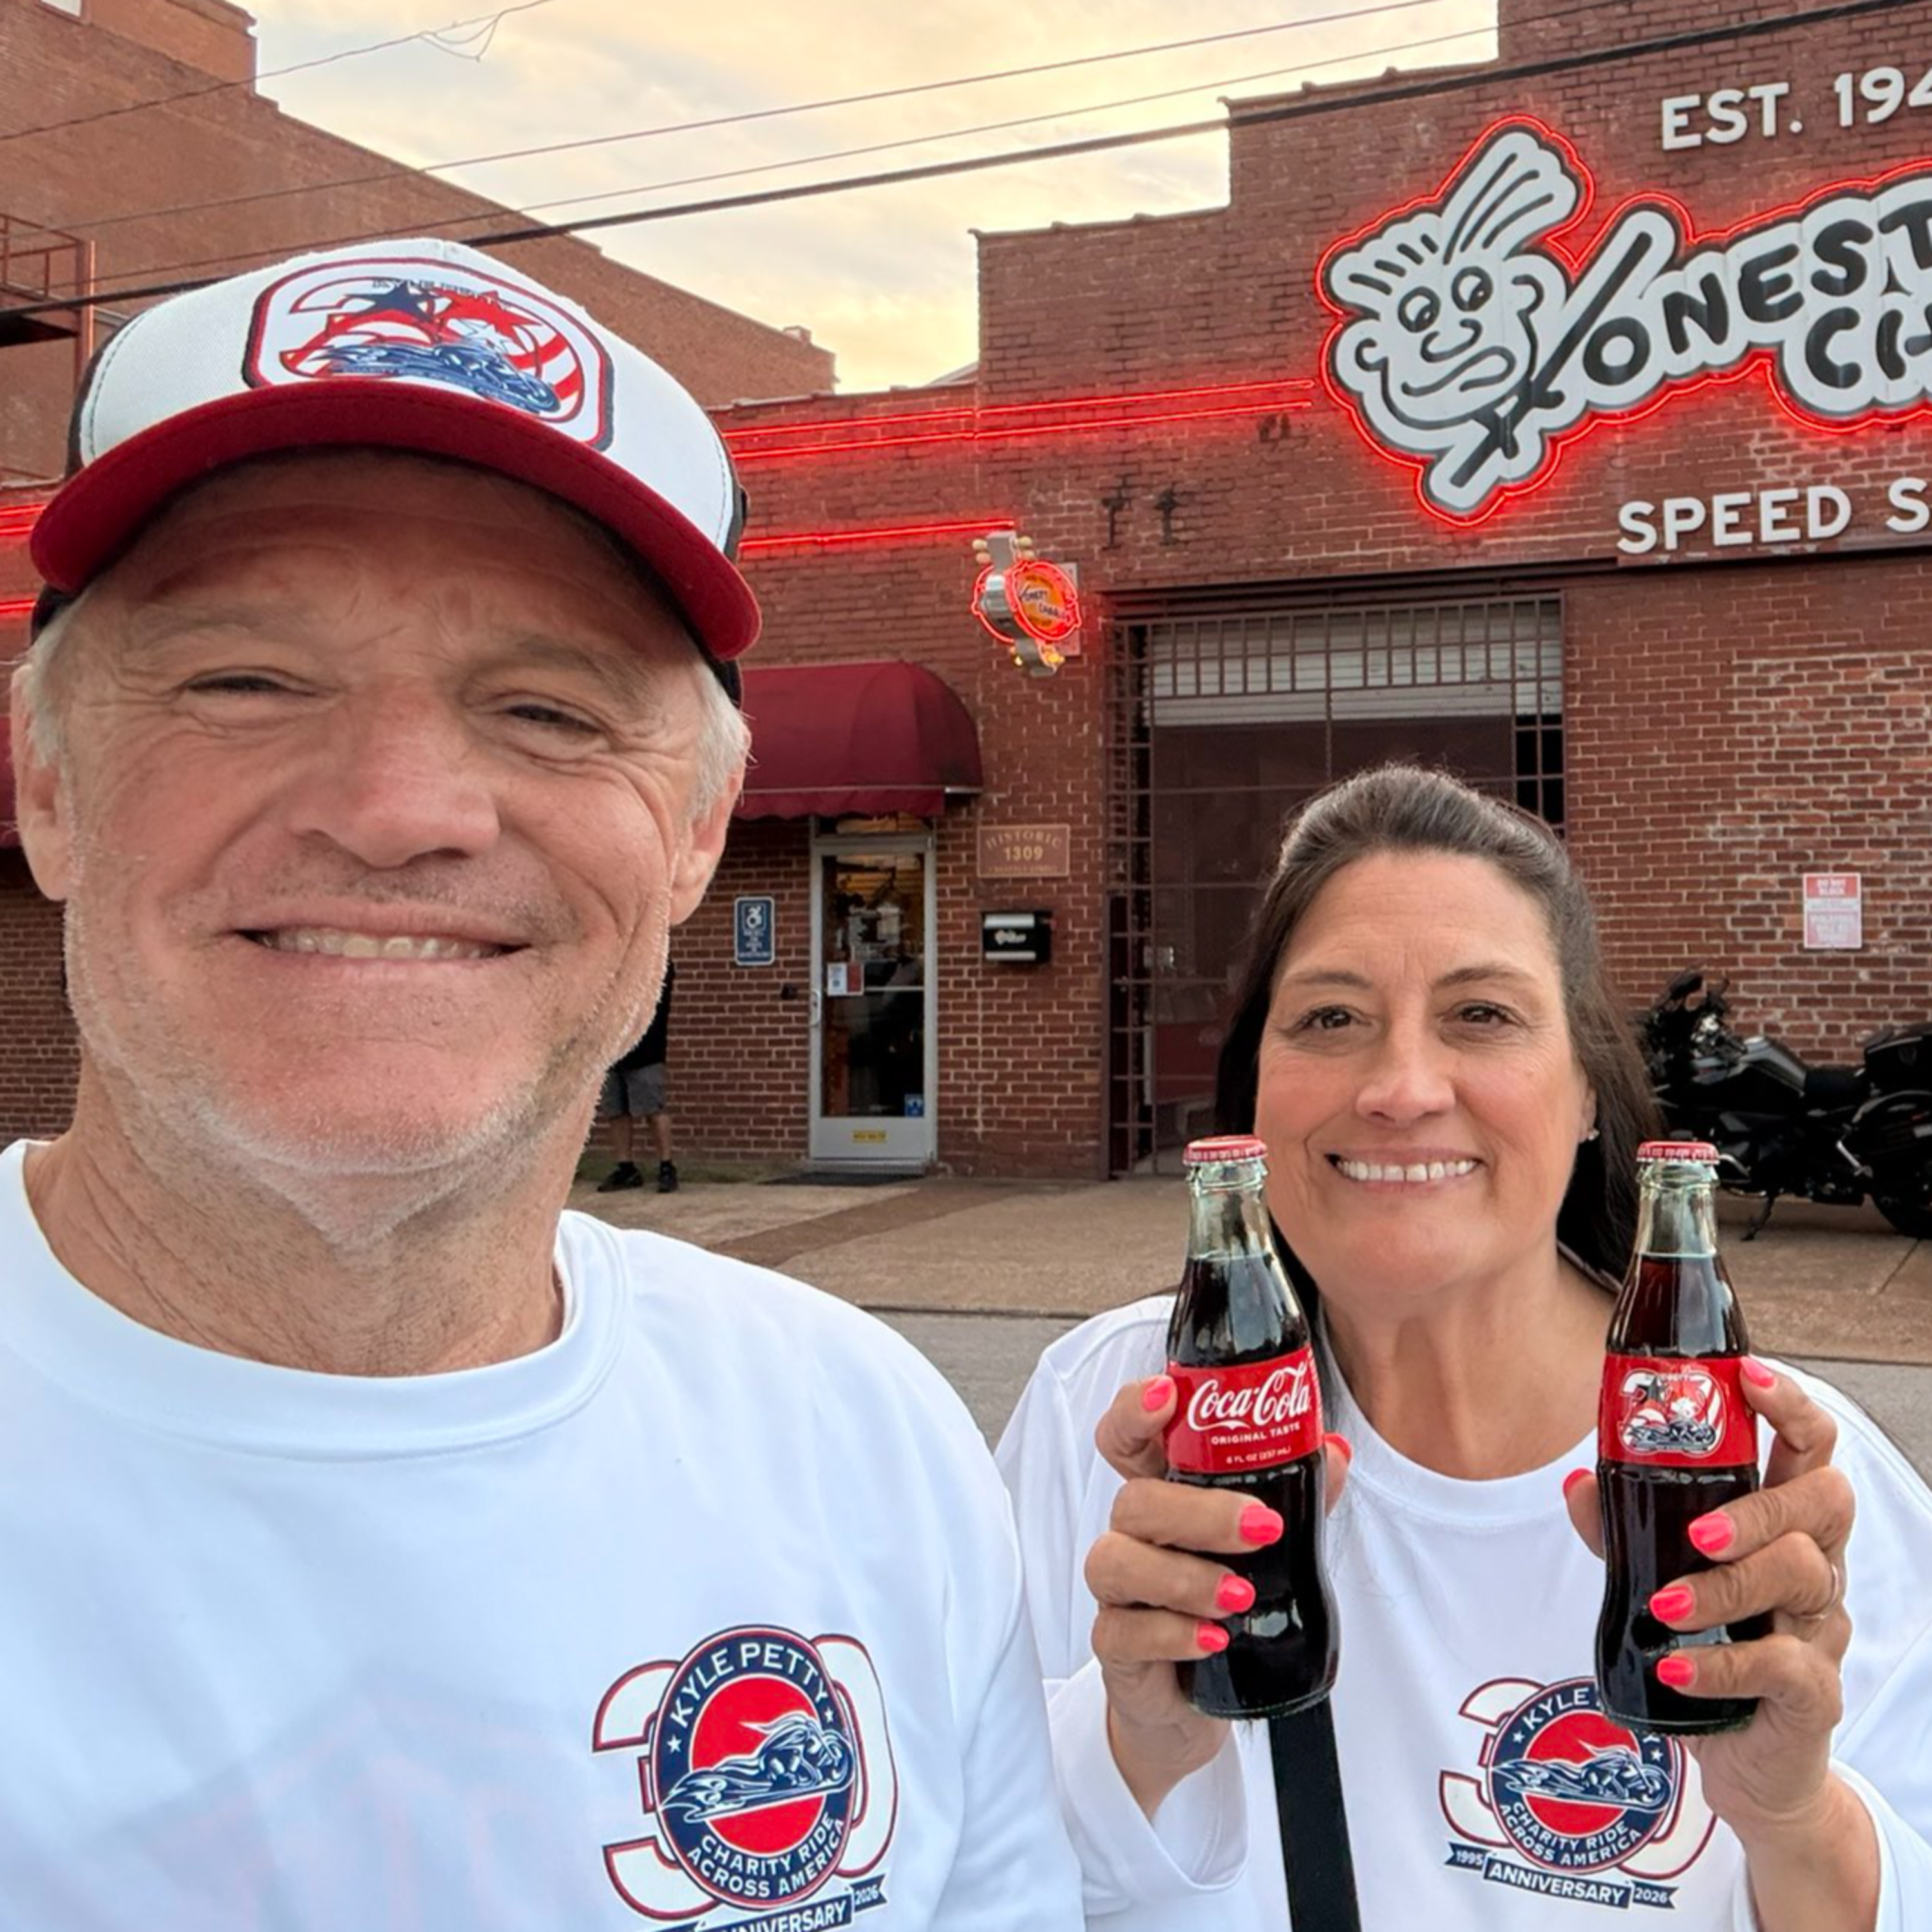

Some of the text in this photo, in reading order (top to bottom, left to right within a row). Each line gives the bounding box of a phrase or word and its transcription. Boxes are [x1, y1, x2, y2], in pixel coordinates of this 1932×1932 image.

[1662, 82, 1802, 151] EST.
[1617, 477, 1930, 554] SPEED S
[1004, 846, 1043, 862] 1309
[1187, 1361, 1312, 1432] Coca-Cola
[1211, 1421, 1301, 1446] ORIGINAL TASTE
[670, 1642, 829, 1728] KYLE PETTY
[1522, 1687, 1590, 1730] KYLE
[701, 1811, 834, 1876] CHARITY RIDE
[1499, 1804, 1642, 1867] ACROSS AMERICA
[1513, 1801, 1628, 1852] CHARITY RIDE
[687, 1818, 844, 1898] ACROSS AMERICA
[1456, 1850, 1483, 1867] 1995
[855, 1884, 880, 1905] 2026
[1488, 1862, 1625, 1906] ANNIVERSARY
[1634, 1886, 1669, 1904] 2026
